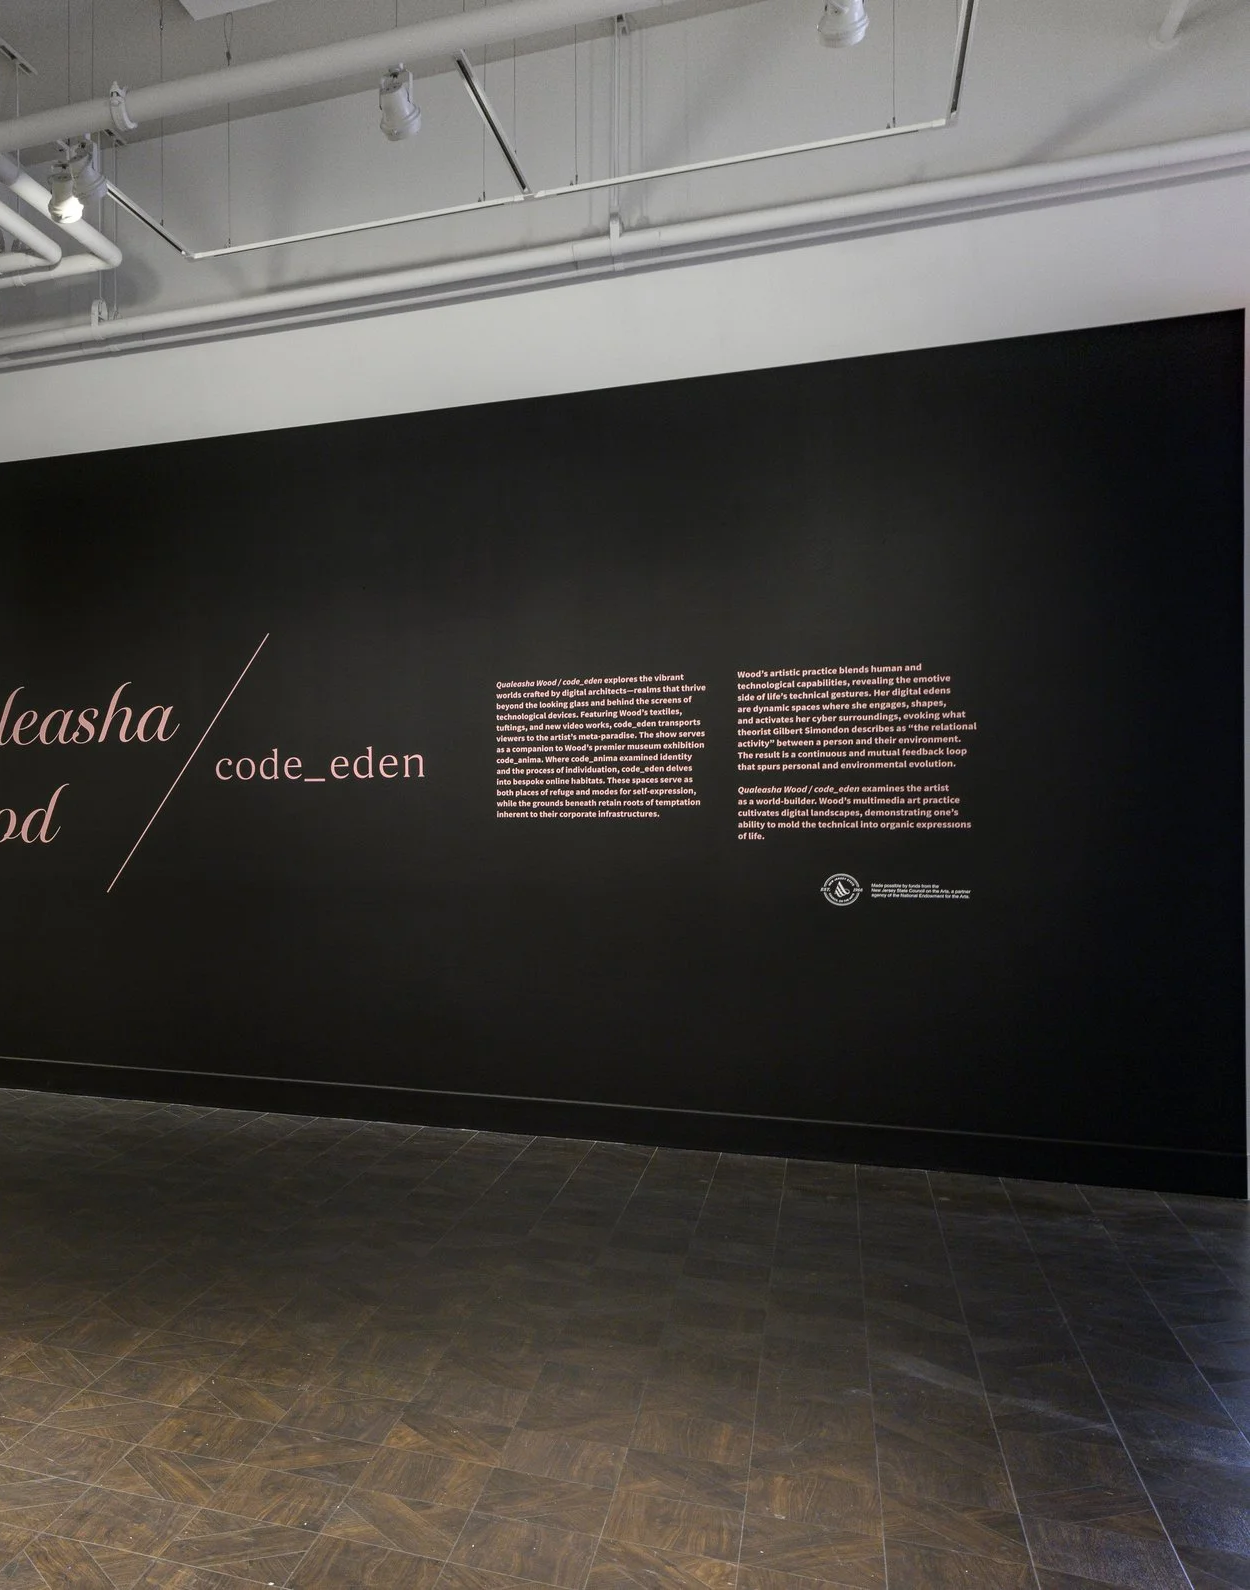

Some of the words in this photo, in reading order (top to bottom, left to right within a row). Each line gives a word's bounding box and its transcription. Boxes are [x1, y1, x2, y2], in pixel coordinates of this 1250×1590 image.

[737, 668, 768, 677] Wood’s
[769, 667, 800, 676] artistic
[801, 665, 837, 677] practice
[838, 664, 869, 674] blends
[870, 663, 902, 673] human
[904, 662, 921, 671] and
[496, 678, 535, 689] Qualeasha
[536, 677, 557, 686] Wood
[562, 675, 602, 686] code_eden
[603, 674, 638, 685] explores
[638, 673, 652, 682] the
[654, 672, 684, 682] vibrant
[737, 678, 795, 691] technological
[796, 677, 850, 689] capabilities,
[851, 675, 894, 687] revealing
[895, 675, 911, 684] the
[913, 673, 950, 683] emotive
[495, 689, 521, 698] worlds
[522, 688, 549, 697] crafted
[550, 688, 560, 698] by
[561, 687, 586, 698] digital
[662, 683, 680, 692] that
[680, 683, 706, 692] thrive
[737, 691, 755, 701] side
[756, 691, 765, 700] of
[766, 690, 787, 700] life’s
[788, 689, 829, 699] technical
[830, 688, 872, 700] gestures.
[873, 687, 890, 696] Her
[891, 686, 921, 698] digital
[923, 685, 950, 695] edens
[496, 710, 546, 722] technological
[547, 709, 579, 718] devices.
[580, 708, 618, 719] Featuring
[618, 707, 648, 716] Wood’s
[649, 706, 682, 717] textiles,
[737, 715, 753, 724] and
[755, 714, 794, 723] activates
[795, 713, 810, 722] her
[811, 713, 837, 724] cyber
[838, 711, 901, 723] surroundings,
[903, 710, 940, 722] evoking
[941, 710, 965, 719] what
[496, 722, 528, 733] tuftings,
[529, 721, 544, 730] and
[562, 720, 584, 729] video
[585, 719, 612, 730] works,
[613, 718, 656, 729] code_eden
[657, 717, 700, 729] transports
[737, 726, 771, 735] theorist
[772, 725, 803, 734] Gilbert
[804, 724, 849, 734] Simondon
[851, 723, 894, 733] describes
[908, 722, 929, 732] “the
[931, 721, 976, 731] relational
[511, 743, 554, 754] companion
[554, 743, 563, 751] to
[564, 742, 593, 751] Wood’s
[593, 741, 626, 752] premier
[662, 740, 704, 749] exhibition
[737, 737, 774, 749] activity”
[776, 737, 814, 746] between
[822, 738, 853, 747] person
[855, 736, 872, 744] and
[874, 735, 896, 744] their
[898, 734, 961, 744] environment.
[216, 746, 425, 782] code_eden
[496, 754, 544, 764] code_anima.
[544, 754, 569, 762] Where
[570, 753, 618, 763] code_anima
[619, 752, 658, 761] examined
[659, 752, 692, 762] identity
[737, 761, 755, 770] that
[756, 763, 780, 771] spurs
[782, 760, 820, 771] personal
[821, 760, 838, 769] and
[840, 759, 907, 768] environmental
[908, 759, 956, 768] evolution.
[496, 765, 510, 774] and
[511, 765, 524, 774] the
[525, 767, 554, 775] process
[555, 765, 564, 773] of
[565, 764, 620, 774] individuation,
[621, 763, 664, 774] code_eden
[665, 763, 692, 772] delves
[496, 787, 514, 796] both
[515, 787, 539, 797] places
[540, 787, 548, 795] of
[549, 787, 574, 797] refuge
[575, 787, 590, 795] and
[591, 787, 618, 795] modes
[619, 786, 631, 795] for
[632, 786, 696, 796] self-expression,
[737, 784, 782, 794] Qualeasha
[783, 784, 807, 792] Wood
[813, 783, 860, 794] code_eden
[861, 783, 904, 792] examines
[906, 783, 922, 792] the
[923, 783, 949, 792] artist
[496, 798, 517, 806] while
[518, 798, 531, 806] the
[532, 798, 564, 808] grounds
[564, 798, 597, 806] beneath
[598, 797, 621, 806] retain
[622, 797, 644, 806] roots
[645, 797, 654, 806] of
[654, 797, 700, 808] temptation
[755, 796, 817, 804] world-builder.
[818, 795, 851, 804] Wood’s
[852, 795, 905, 804] multimedia
[906, 795, 921, 803] art
[922, 795, 960, 805] practice
[496, 809, 528, 817] inherent
[529, 809, 538, 817] to
[539, 809, 558, 817] their
[558, 809, 597, 819] corporate
[597, 809, 660, 817] infrastructures.
[737, 807, 779, 816] cultivates
[780, 807, 809, 818] digital
[810, 807, 863, 818] landscapes,
[864, 807, 932, 818] demonstrating
[933, 807, 958, 816] one’s
